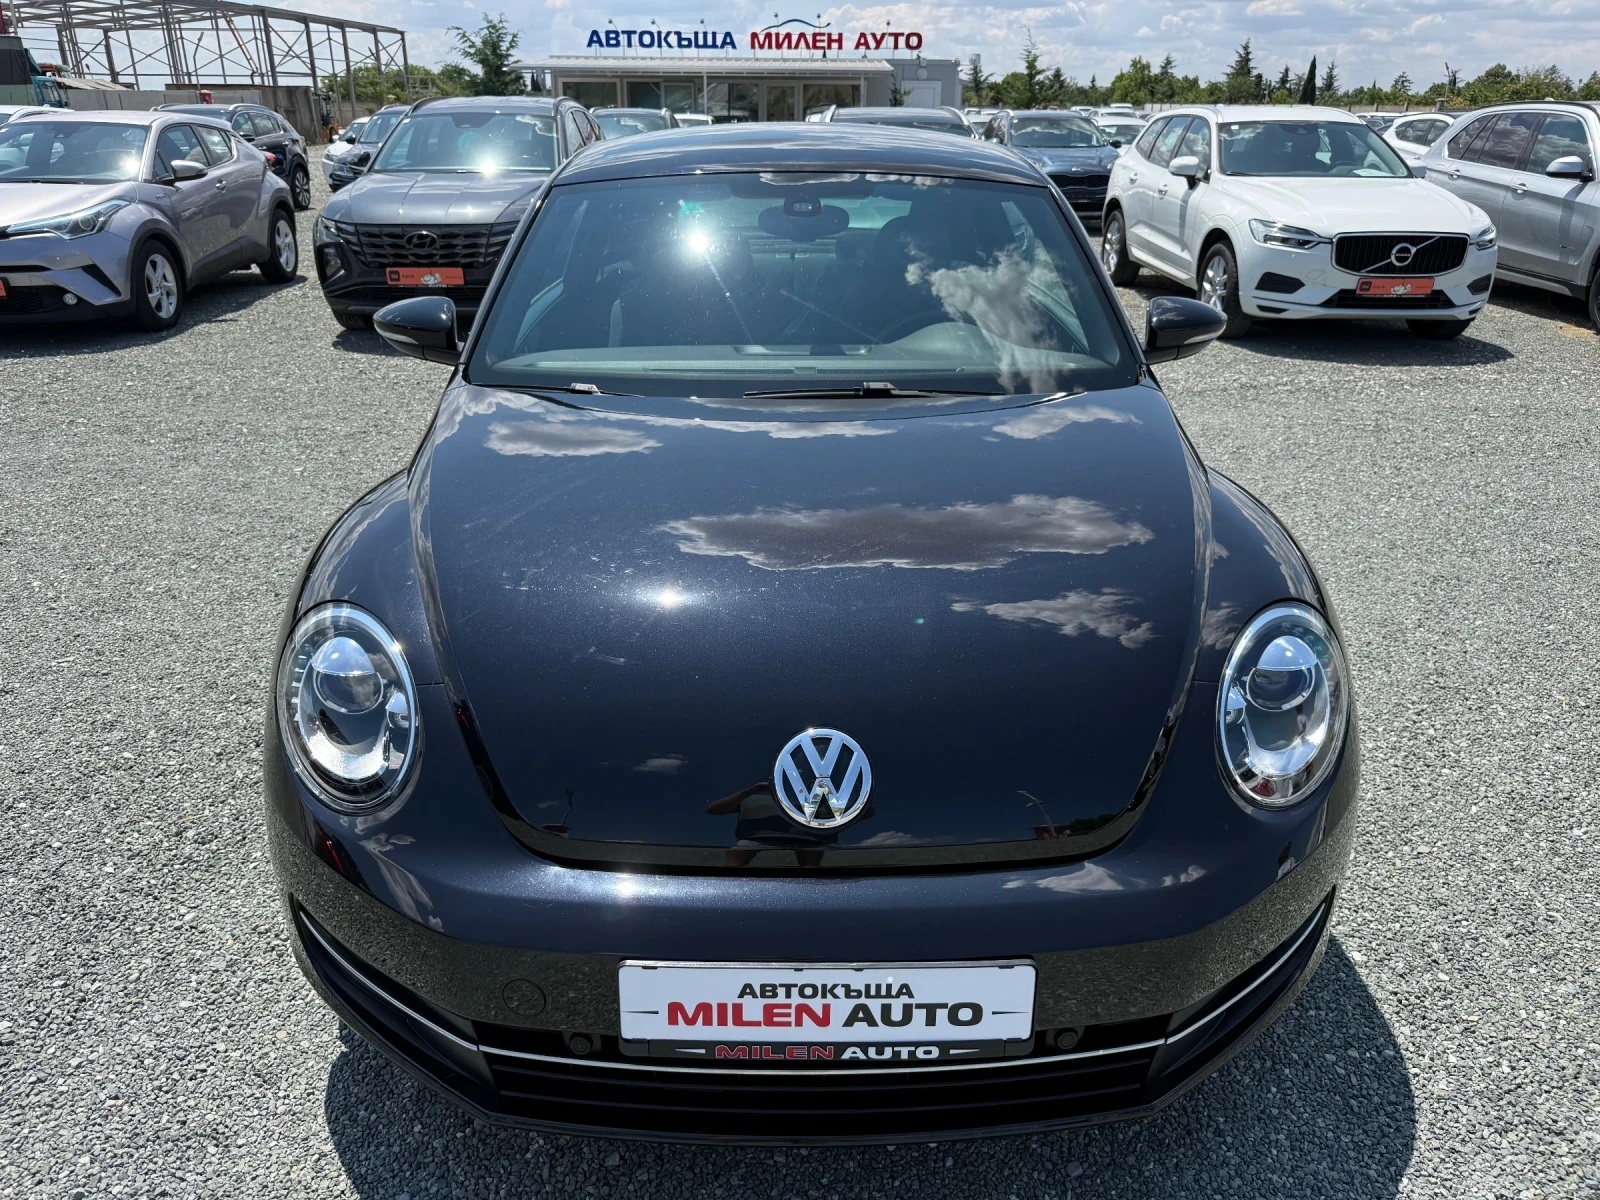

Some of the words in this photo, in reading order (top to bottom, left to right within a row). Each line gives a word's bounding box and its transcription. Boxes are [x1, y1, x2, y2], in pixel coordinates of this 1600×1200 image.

[586, 30, 737, 49] АВТОКЪЩА
[750, 31, 843, 50] МИЛЕН
[854, 32, 923, 50] АУТО
[737, 983, 915, 999] АВТОКЪЩА
[667, 1001, 831, 1028] MILEN
[841, 1002, 984, 1028] AUTO
[715, 1044, 834, 1060] MILEN
[840, 1045, 940, 1060] AUTO
